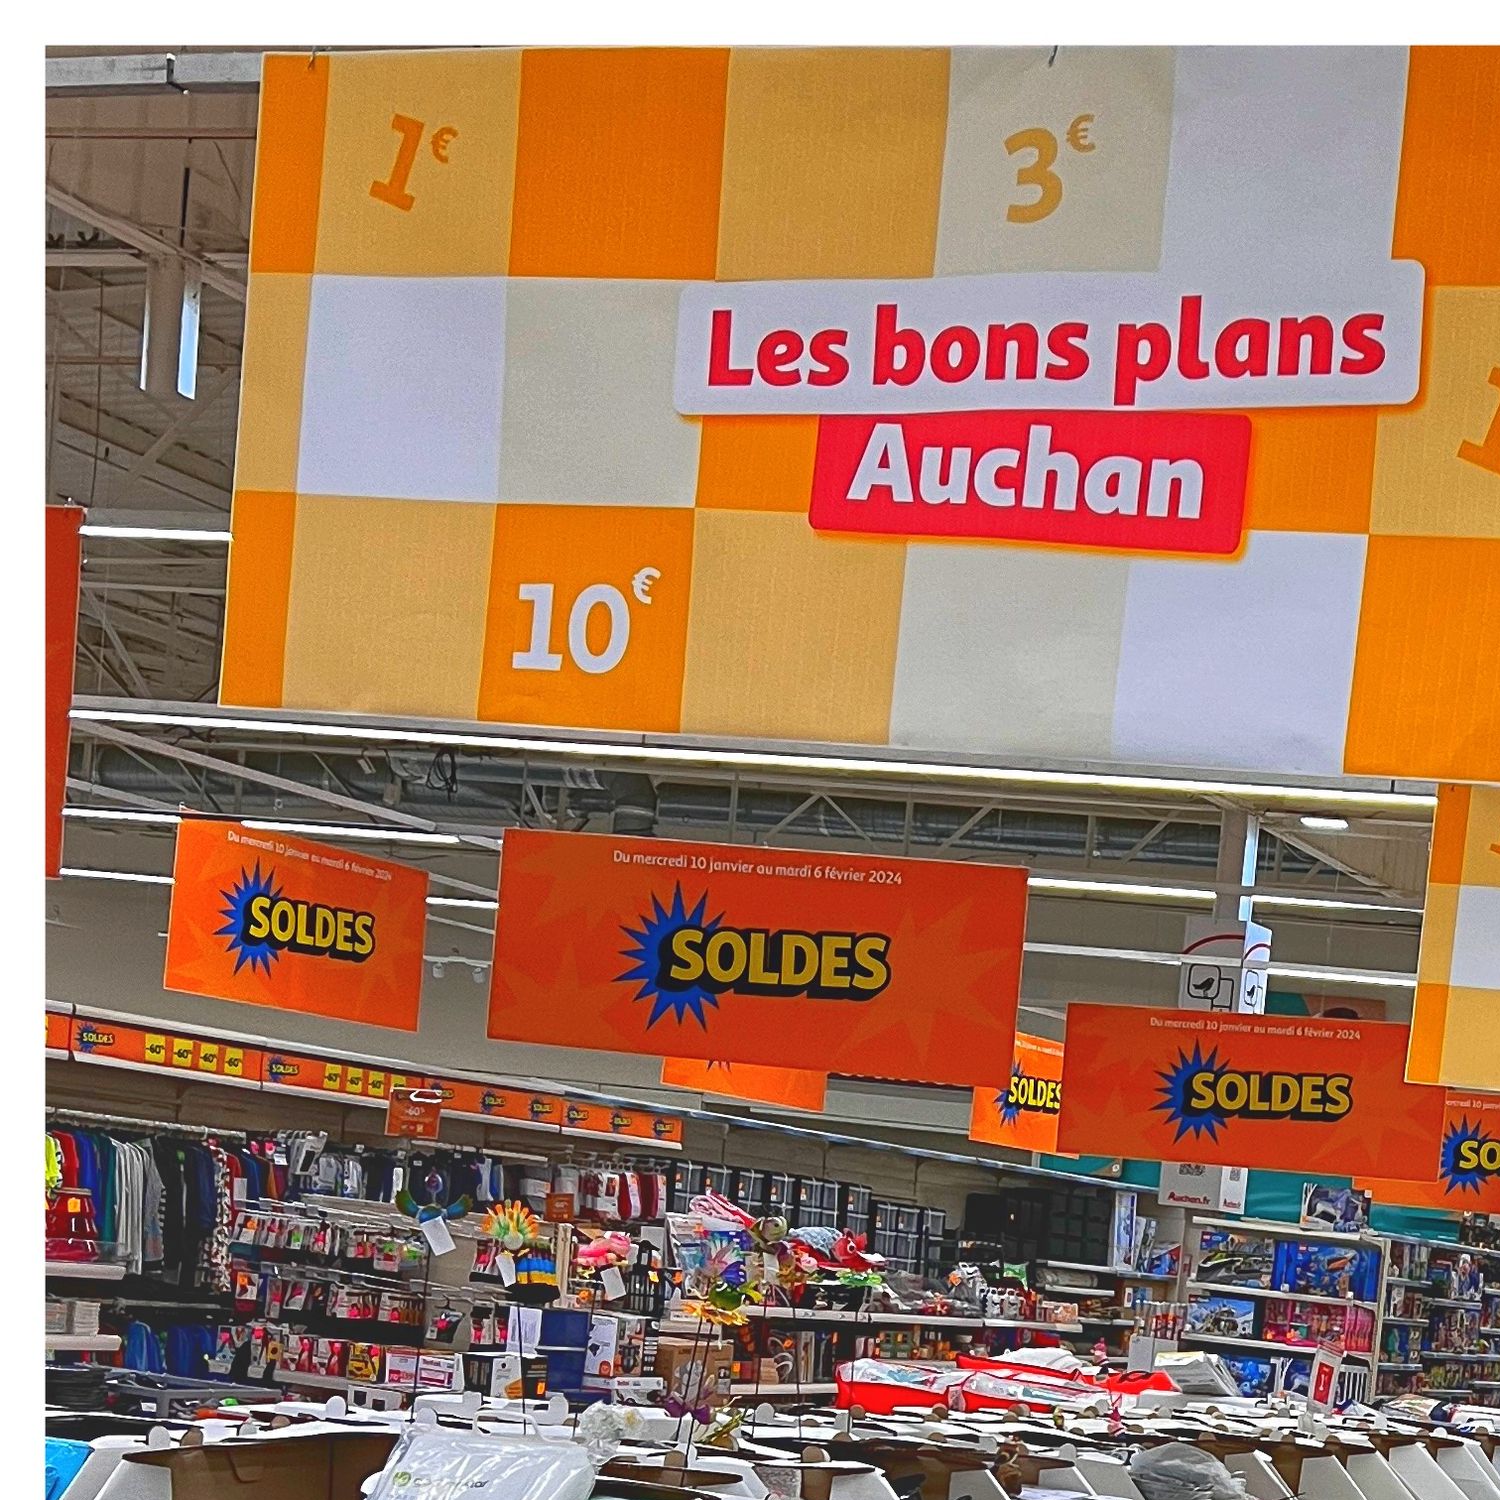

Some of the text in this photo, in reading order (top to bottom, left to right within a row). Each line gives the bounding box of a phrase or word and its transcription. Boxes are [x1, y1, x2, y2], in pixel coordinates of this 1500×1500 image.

[368, 113, 458, 212] 1€
[1003, 112, 1098, 224] 3€
[707, 294, 1387, 406] Les bons plans
[846, 420, 1205, 520] Auchan
[510, 566, 661, 674] 10€
[613, 850, 902, 885] Du mercredi 10 janvier au mardi 6 février 2024
[249, 897, 375, 955] SOLDES
[670, 928, 888, 990] SOLDES
[1008, 1076, 1062, 1109] SOLDES
[1190, 1070, 1352, 1116] SOLDES
